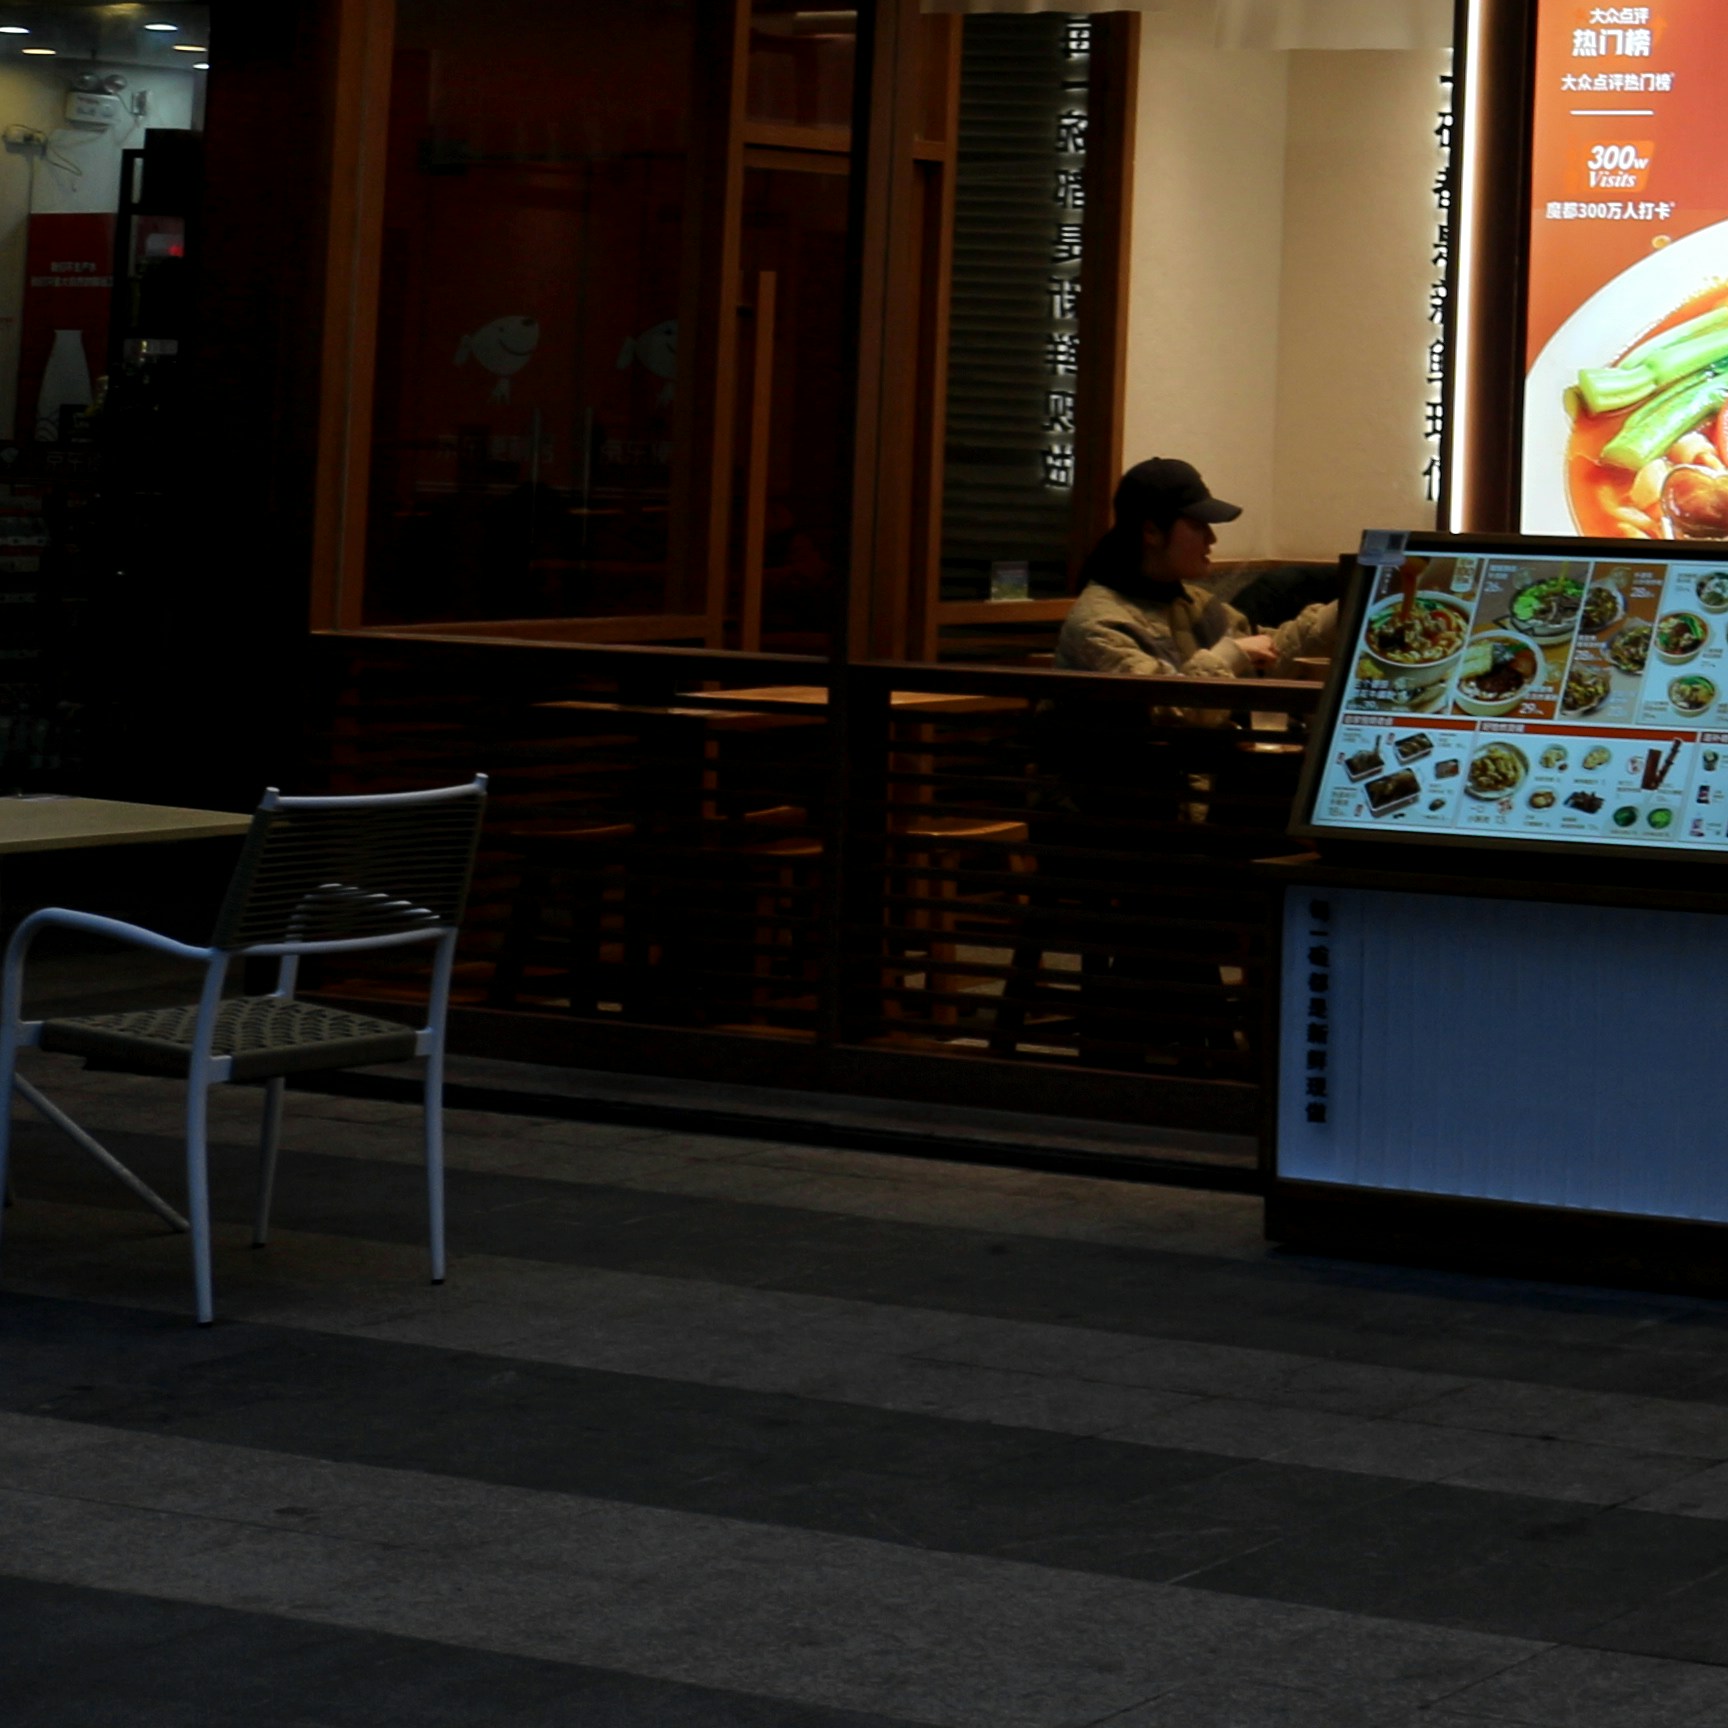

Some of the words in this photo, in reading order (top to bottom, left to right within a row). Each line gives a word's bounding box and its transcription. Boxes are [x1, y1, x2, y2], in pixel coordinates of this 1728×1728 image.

[1590, 7, 1650, 24] 大众点评
[1572, 29, 1651, 57] 热门榜
[1588, 170, 1637, 188] Visits
